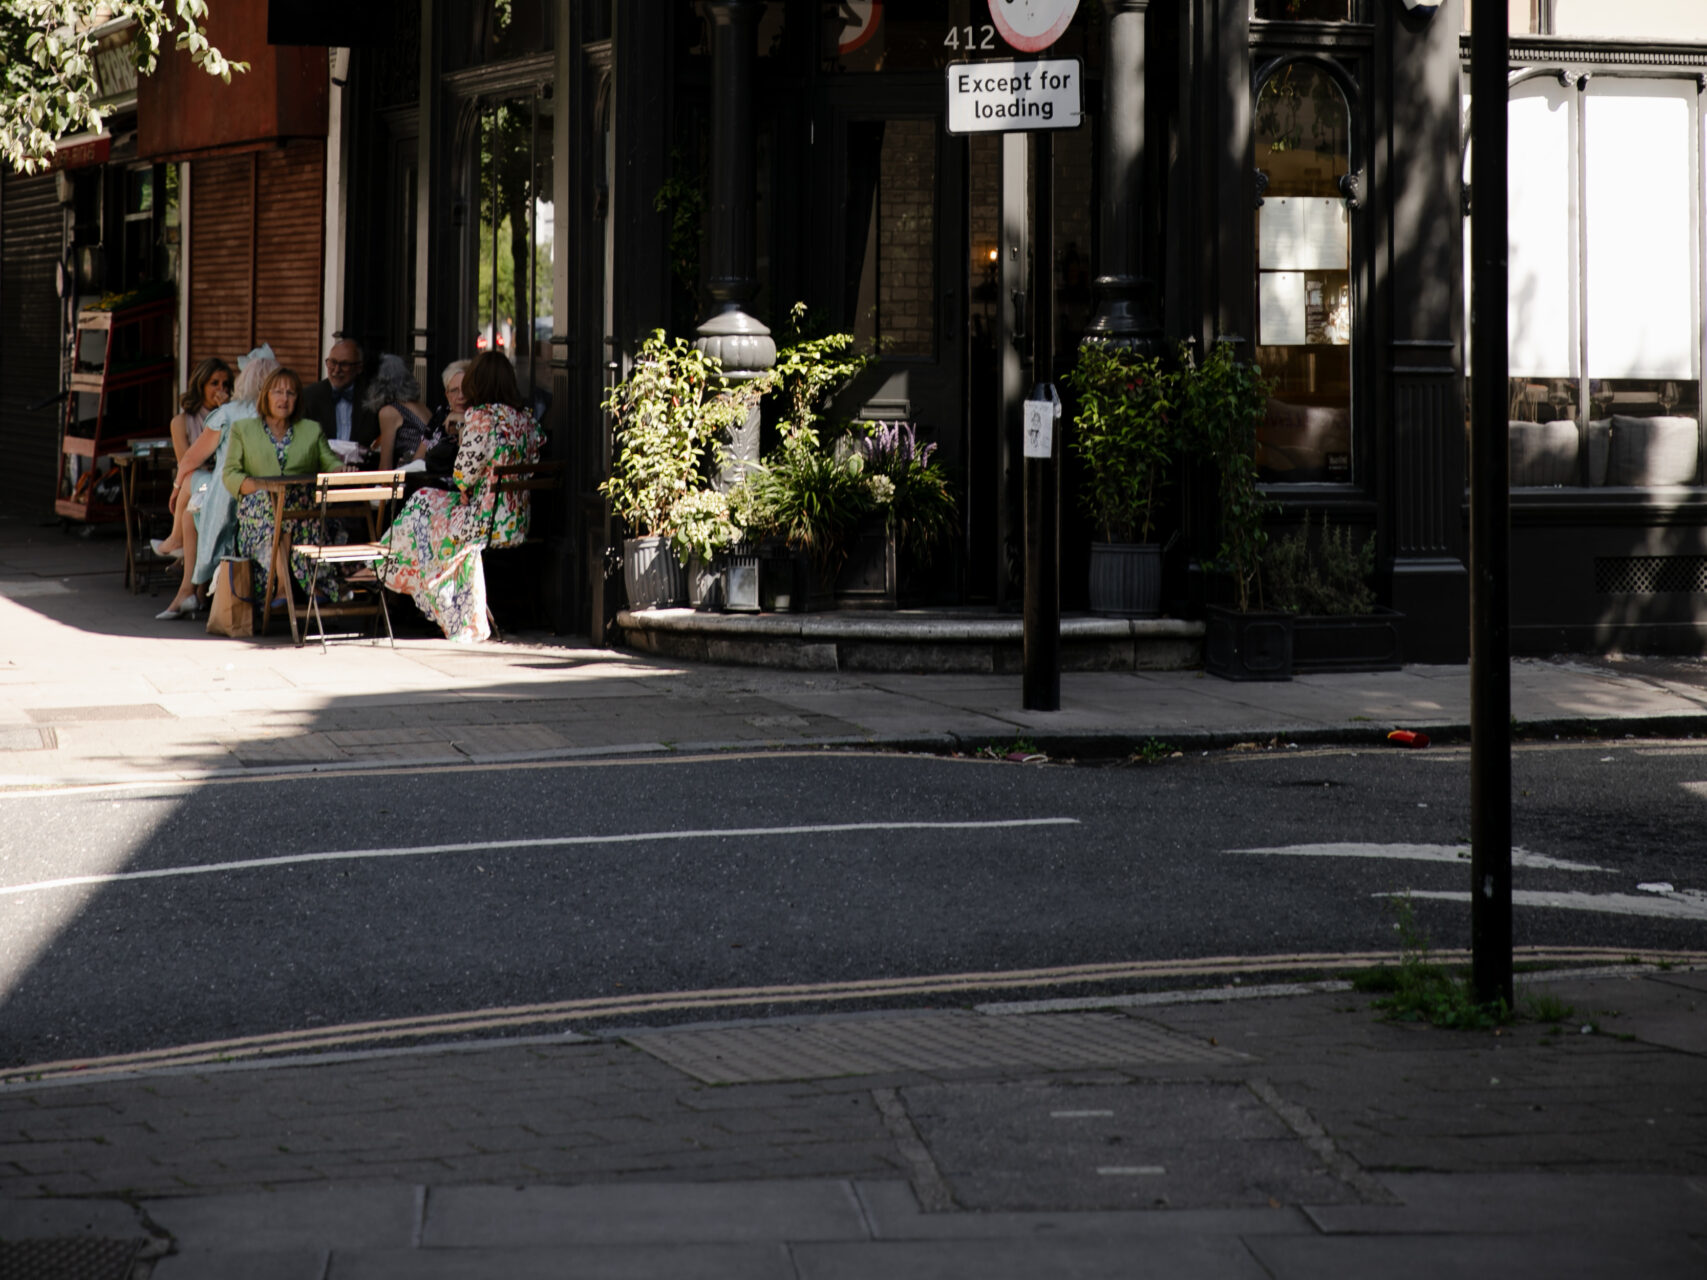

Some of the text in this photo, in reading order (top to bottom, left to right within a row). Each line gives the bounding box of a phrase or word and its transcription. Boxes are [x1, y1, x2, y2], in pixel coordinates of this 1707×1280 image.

[944, 24, 996, 51] 412
[957, 70, 1071, 96] Except for
[974, 97, 1055, 121] loading
